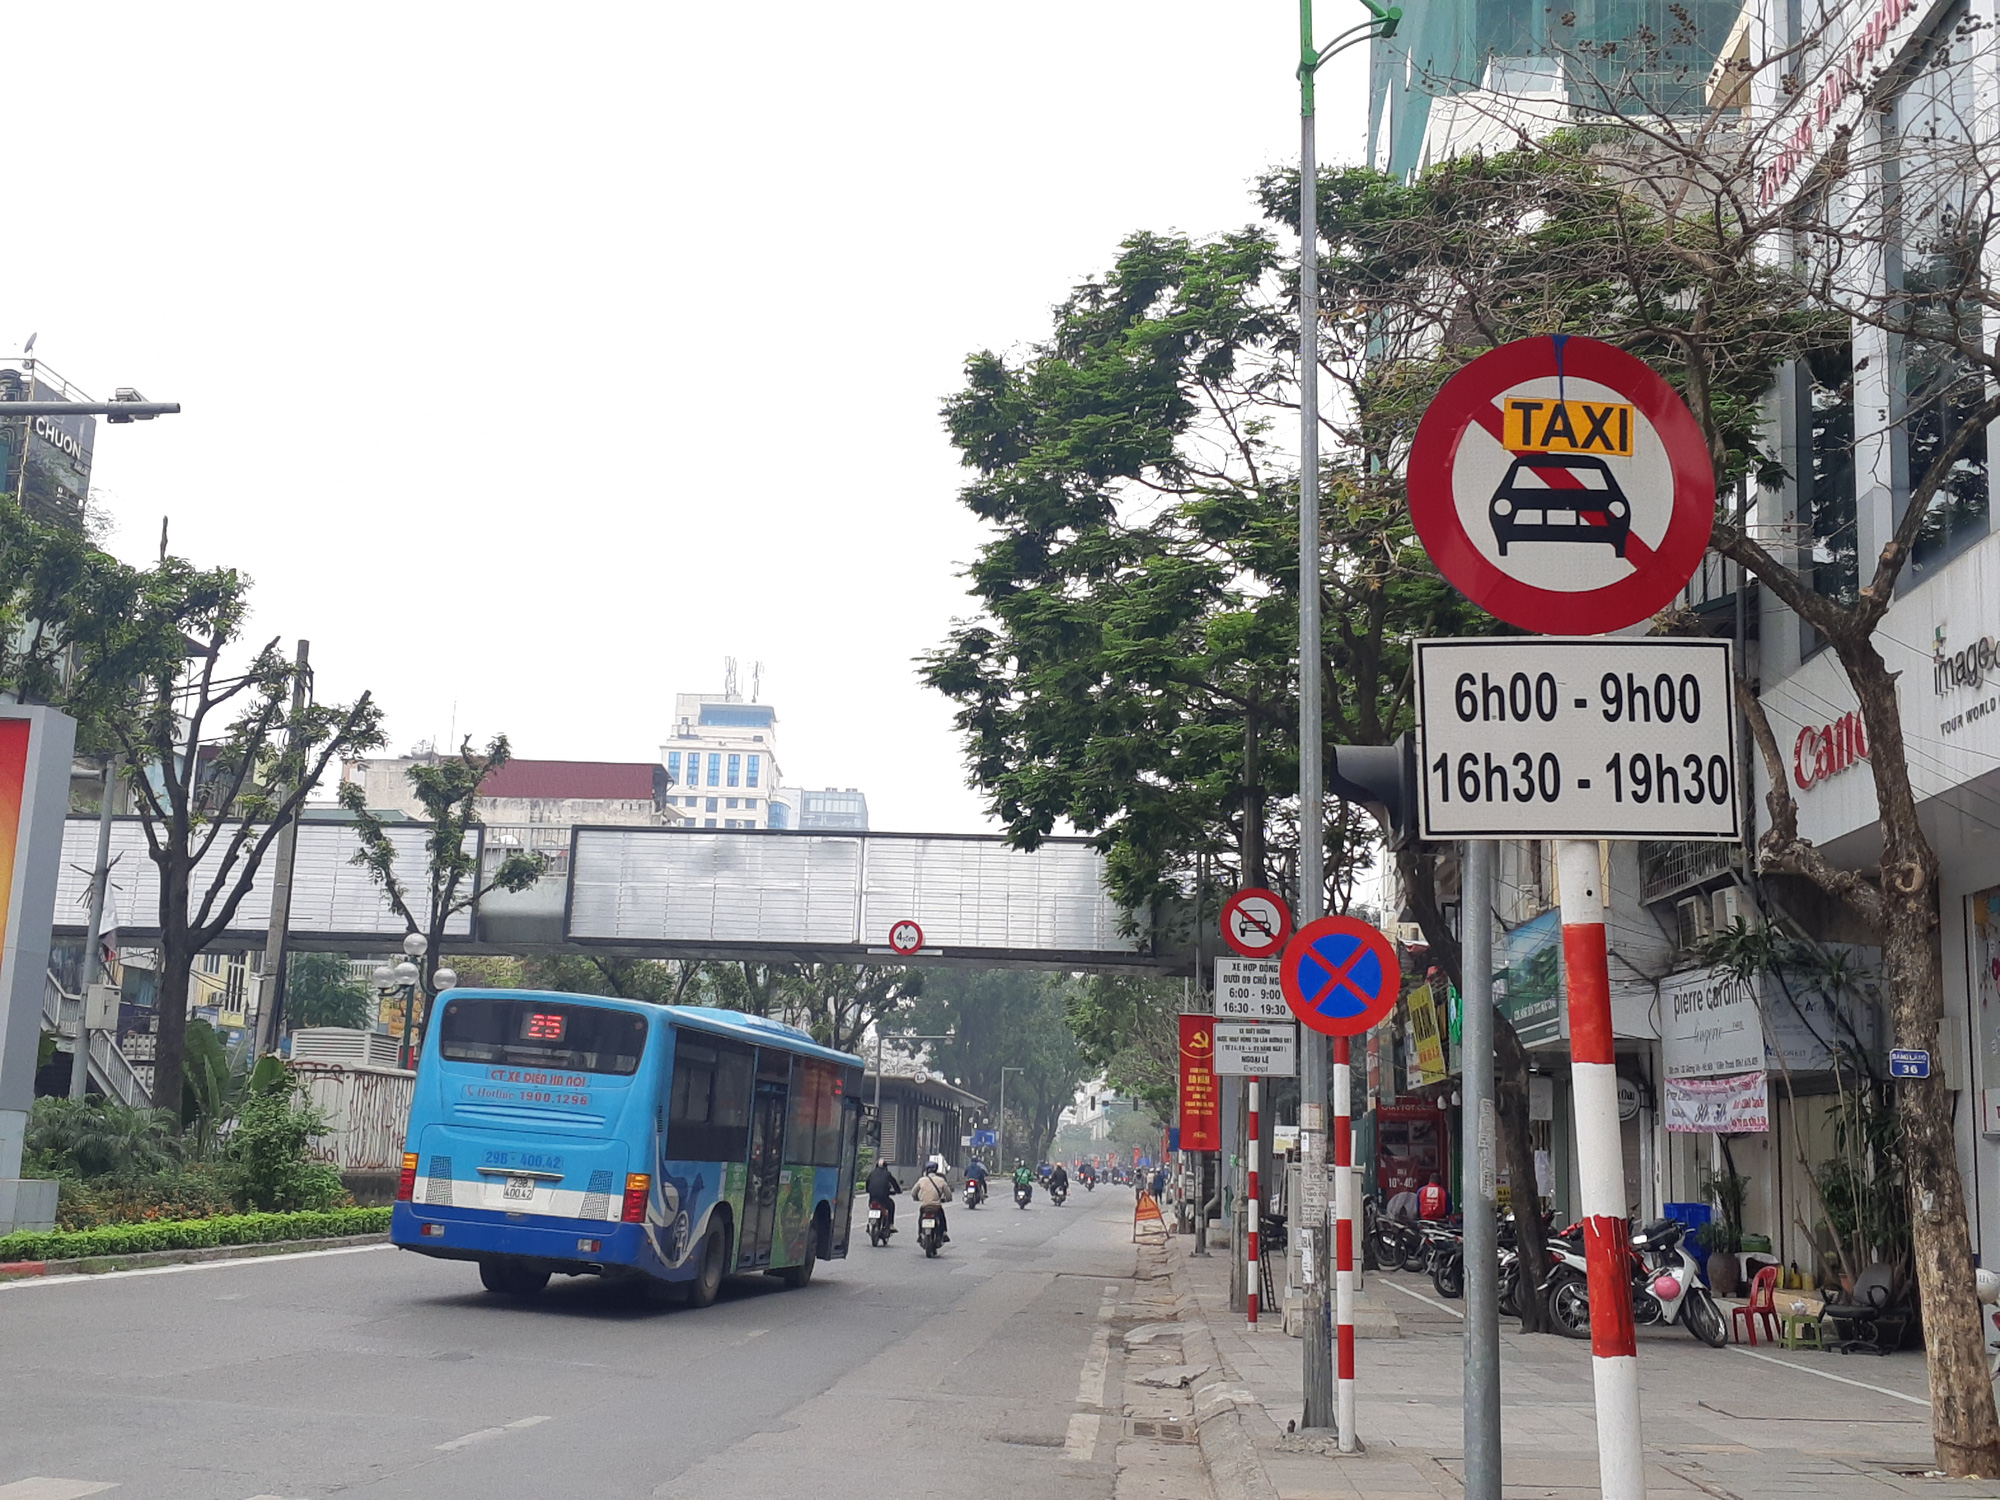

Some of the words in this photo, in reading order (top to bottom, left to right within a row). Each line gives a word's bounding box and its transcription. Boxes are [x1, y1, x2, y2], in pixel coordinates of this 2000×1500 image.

[1511, 402, 1628, 452] TAXI
[36, 417, 82, 460] CHUON
[1455, 672, 1557, 722] 6h00
[1574, 699, 1587, 708] -
[1600, 672, 1700, 723] 9h00
[1940, 714, 1963, 737] YOUR
[1966, 697, 1996, 724] WORLD
[1432, 752, 1561, 803] 16h30
[1577, 779, 1590, 789] -
[1606, 752, 1729, 805] 19h30
[1232, 963, 1241, 971] XE
[1242, 976, 1251, 984] 09
[1229, 987, 1249, 998] 6:00
[1260, 989, 1281, 1000] 9:00
[1223, 1002, 1249, 1013] 16:30
[1260, 1004, 1286, 1015] 19:30
[1673, 985, 1704, 1022] pierre
[528, 1014, 563, 1038] 25
[491, 1070, 506, 1080] CT
[508, 1071, 520, 1082] XE
[1902, 1064, 1918, 1074] 36
[478, 1088, 514, 1099] Hotline
[520, 1091, 588, 1106] 1900.1296
[486, 1151, 508, 1165] 29B
[520, 1154, 561, 1169] 400.42
